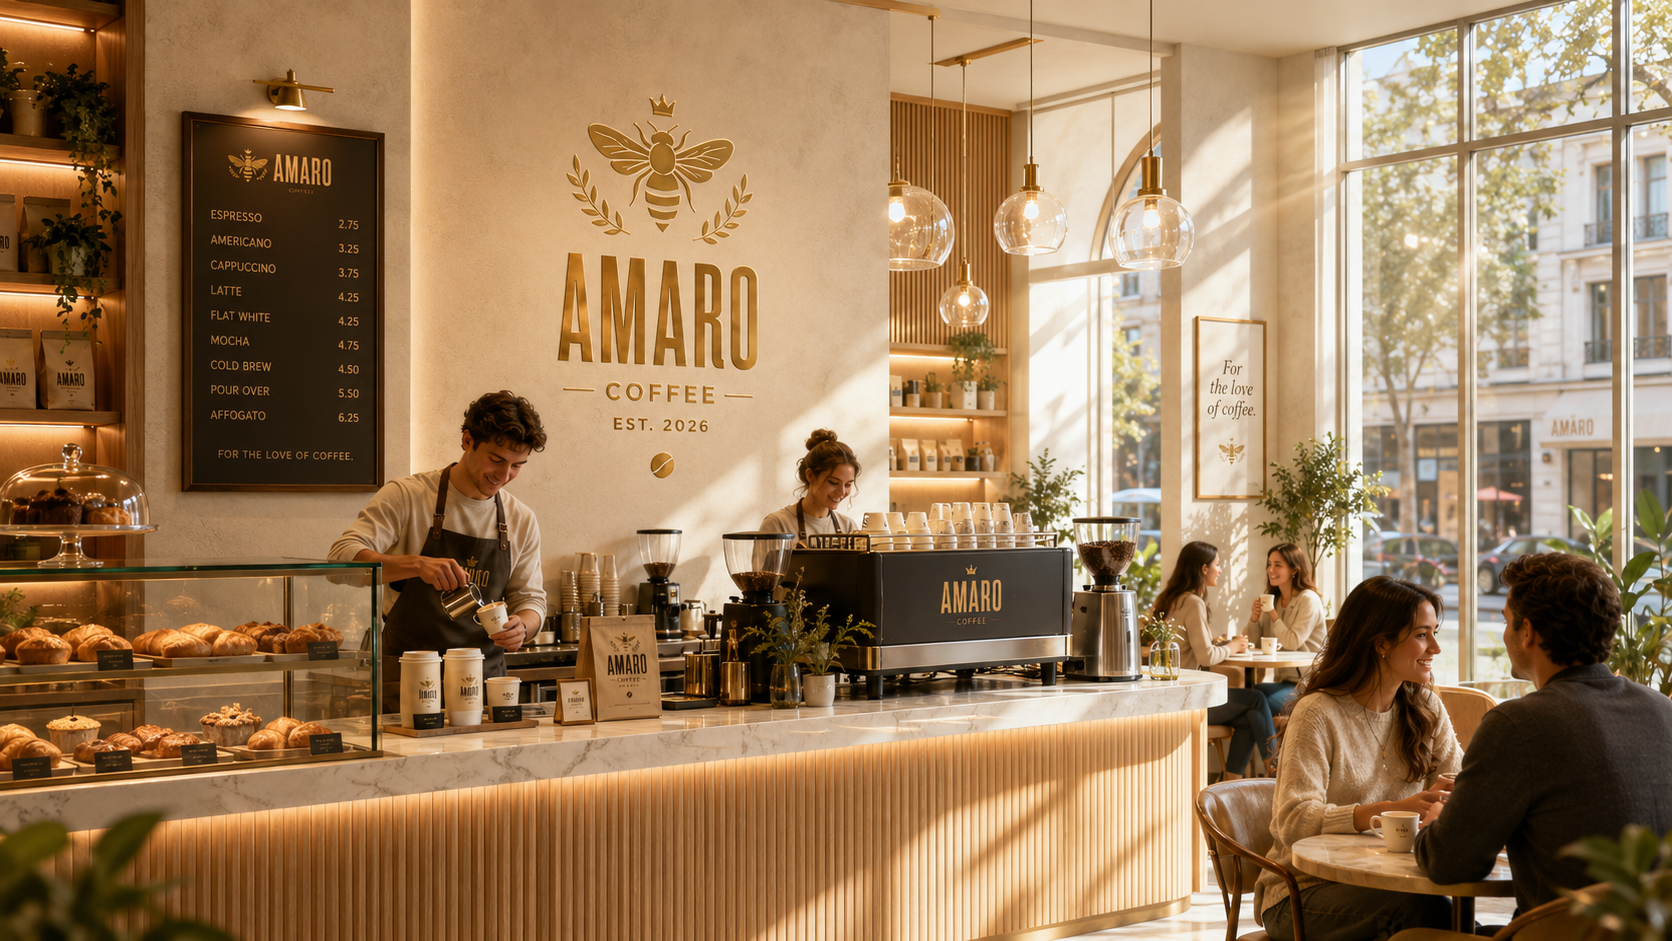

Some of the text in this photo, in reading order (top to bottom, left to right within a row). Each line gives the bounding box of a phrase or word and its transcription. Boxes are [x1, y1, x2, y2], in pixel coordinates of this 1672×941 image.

[273, 153, 332, 187] AMARO
[211, 209, 359, 230] ESPRESSO 2.75
[210, 234, 360, 255] AMERICANO 3.25
[210, 259, 359, 279] CAPPUCCINO 3.75
[210, 285, 360, 303] LATTE 4.25
[210, 309, 360, 327] FLAT WHITE 4.25
[557, 252, 758, 371] AMARO
[210, 335, 360, 351] MOCHA 4.75
[210, 359, 360, 375] COLD BREW 4.50
[1223, 360, 1243, 376] For
[56, 371, 85, 387] AMARO
[1210, 378, 1254, 397] the love
[210, 384, 360, 399] POUR OVER 5.50
[606, 381, 715, 404] COFFEE
[210, 409, 360, 423] AFFOGATO 6.25
[1207, 399, 1256, 420] of coffee.
[613, 417, 709, 433] EST. 2026
[1551, 418, 1594, 437] AMARO
[218, 449, 354, 461] FOR THE LOVE OF COFFEE.
[940, 579, 1002, 614] AMARO
[956, 617, 987, 626] COFFEE
[607, 653, 648, 676] AMARO
